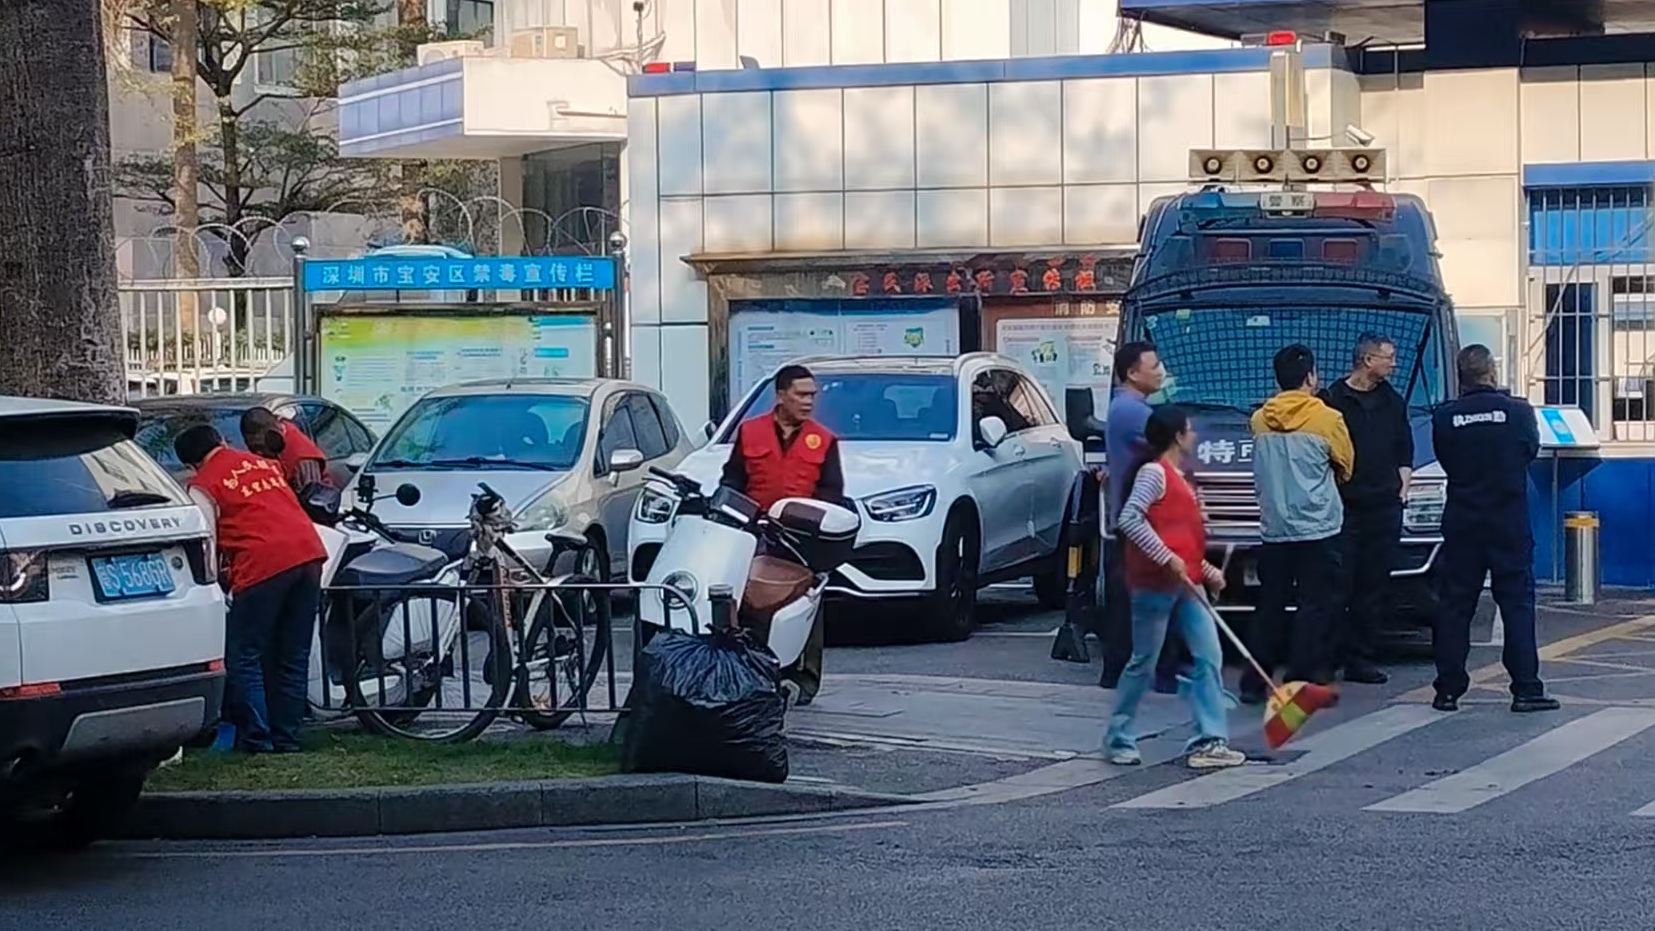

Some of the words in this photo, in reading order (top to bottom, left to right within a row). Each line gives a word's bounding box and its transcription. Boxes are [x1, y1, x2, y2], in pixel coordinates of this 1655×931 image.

[322, 263, 594, 285] 深圳市宝安区禁毒宣传栏
[69, 517, 182, 535] DISCOVERY
